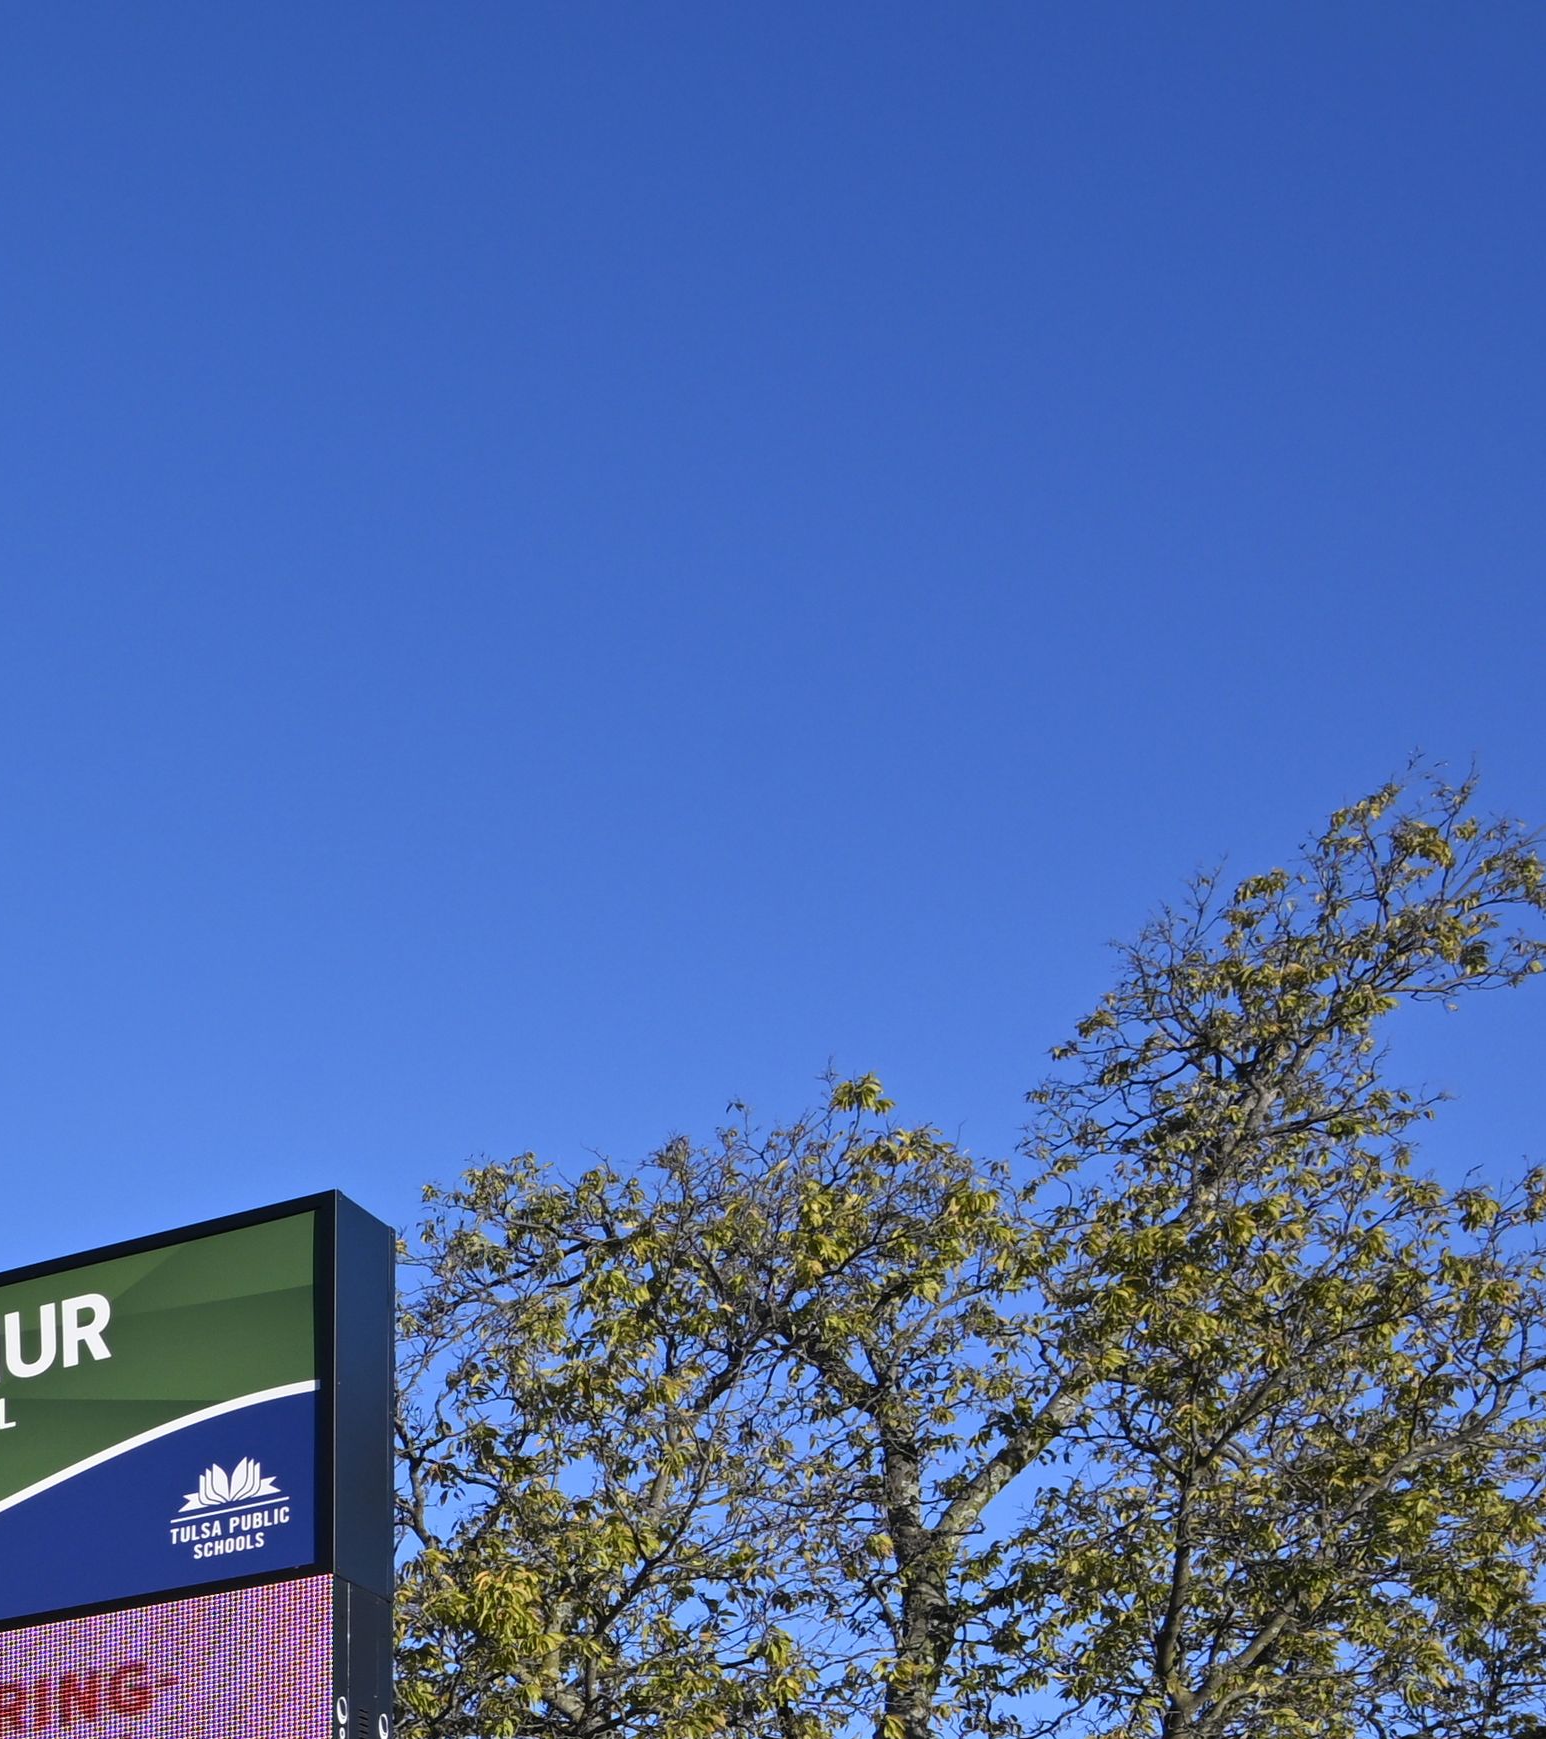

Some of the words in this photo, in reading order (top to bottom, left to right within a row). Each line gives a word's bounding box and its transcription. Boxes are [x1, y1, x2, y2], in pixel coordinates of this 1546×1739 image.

[170, 1520, 222, 1545] TULSA
[229, 1506, 290, 1534] PUBLIC
[193, 1532, 265, 1559] SCHOOLS
